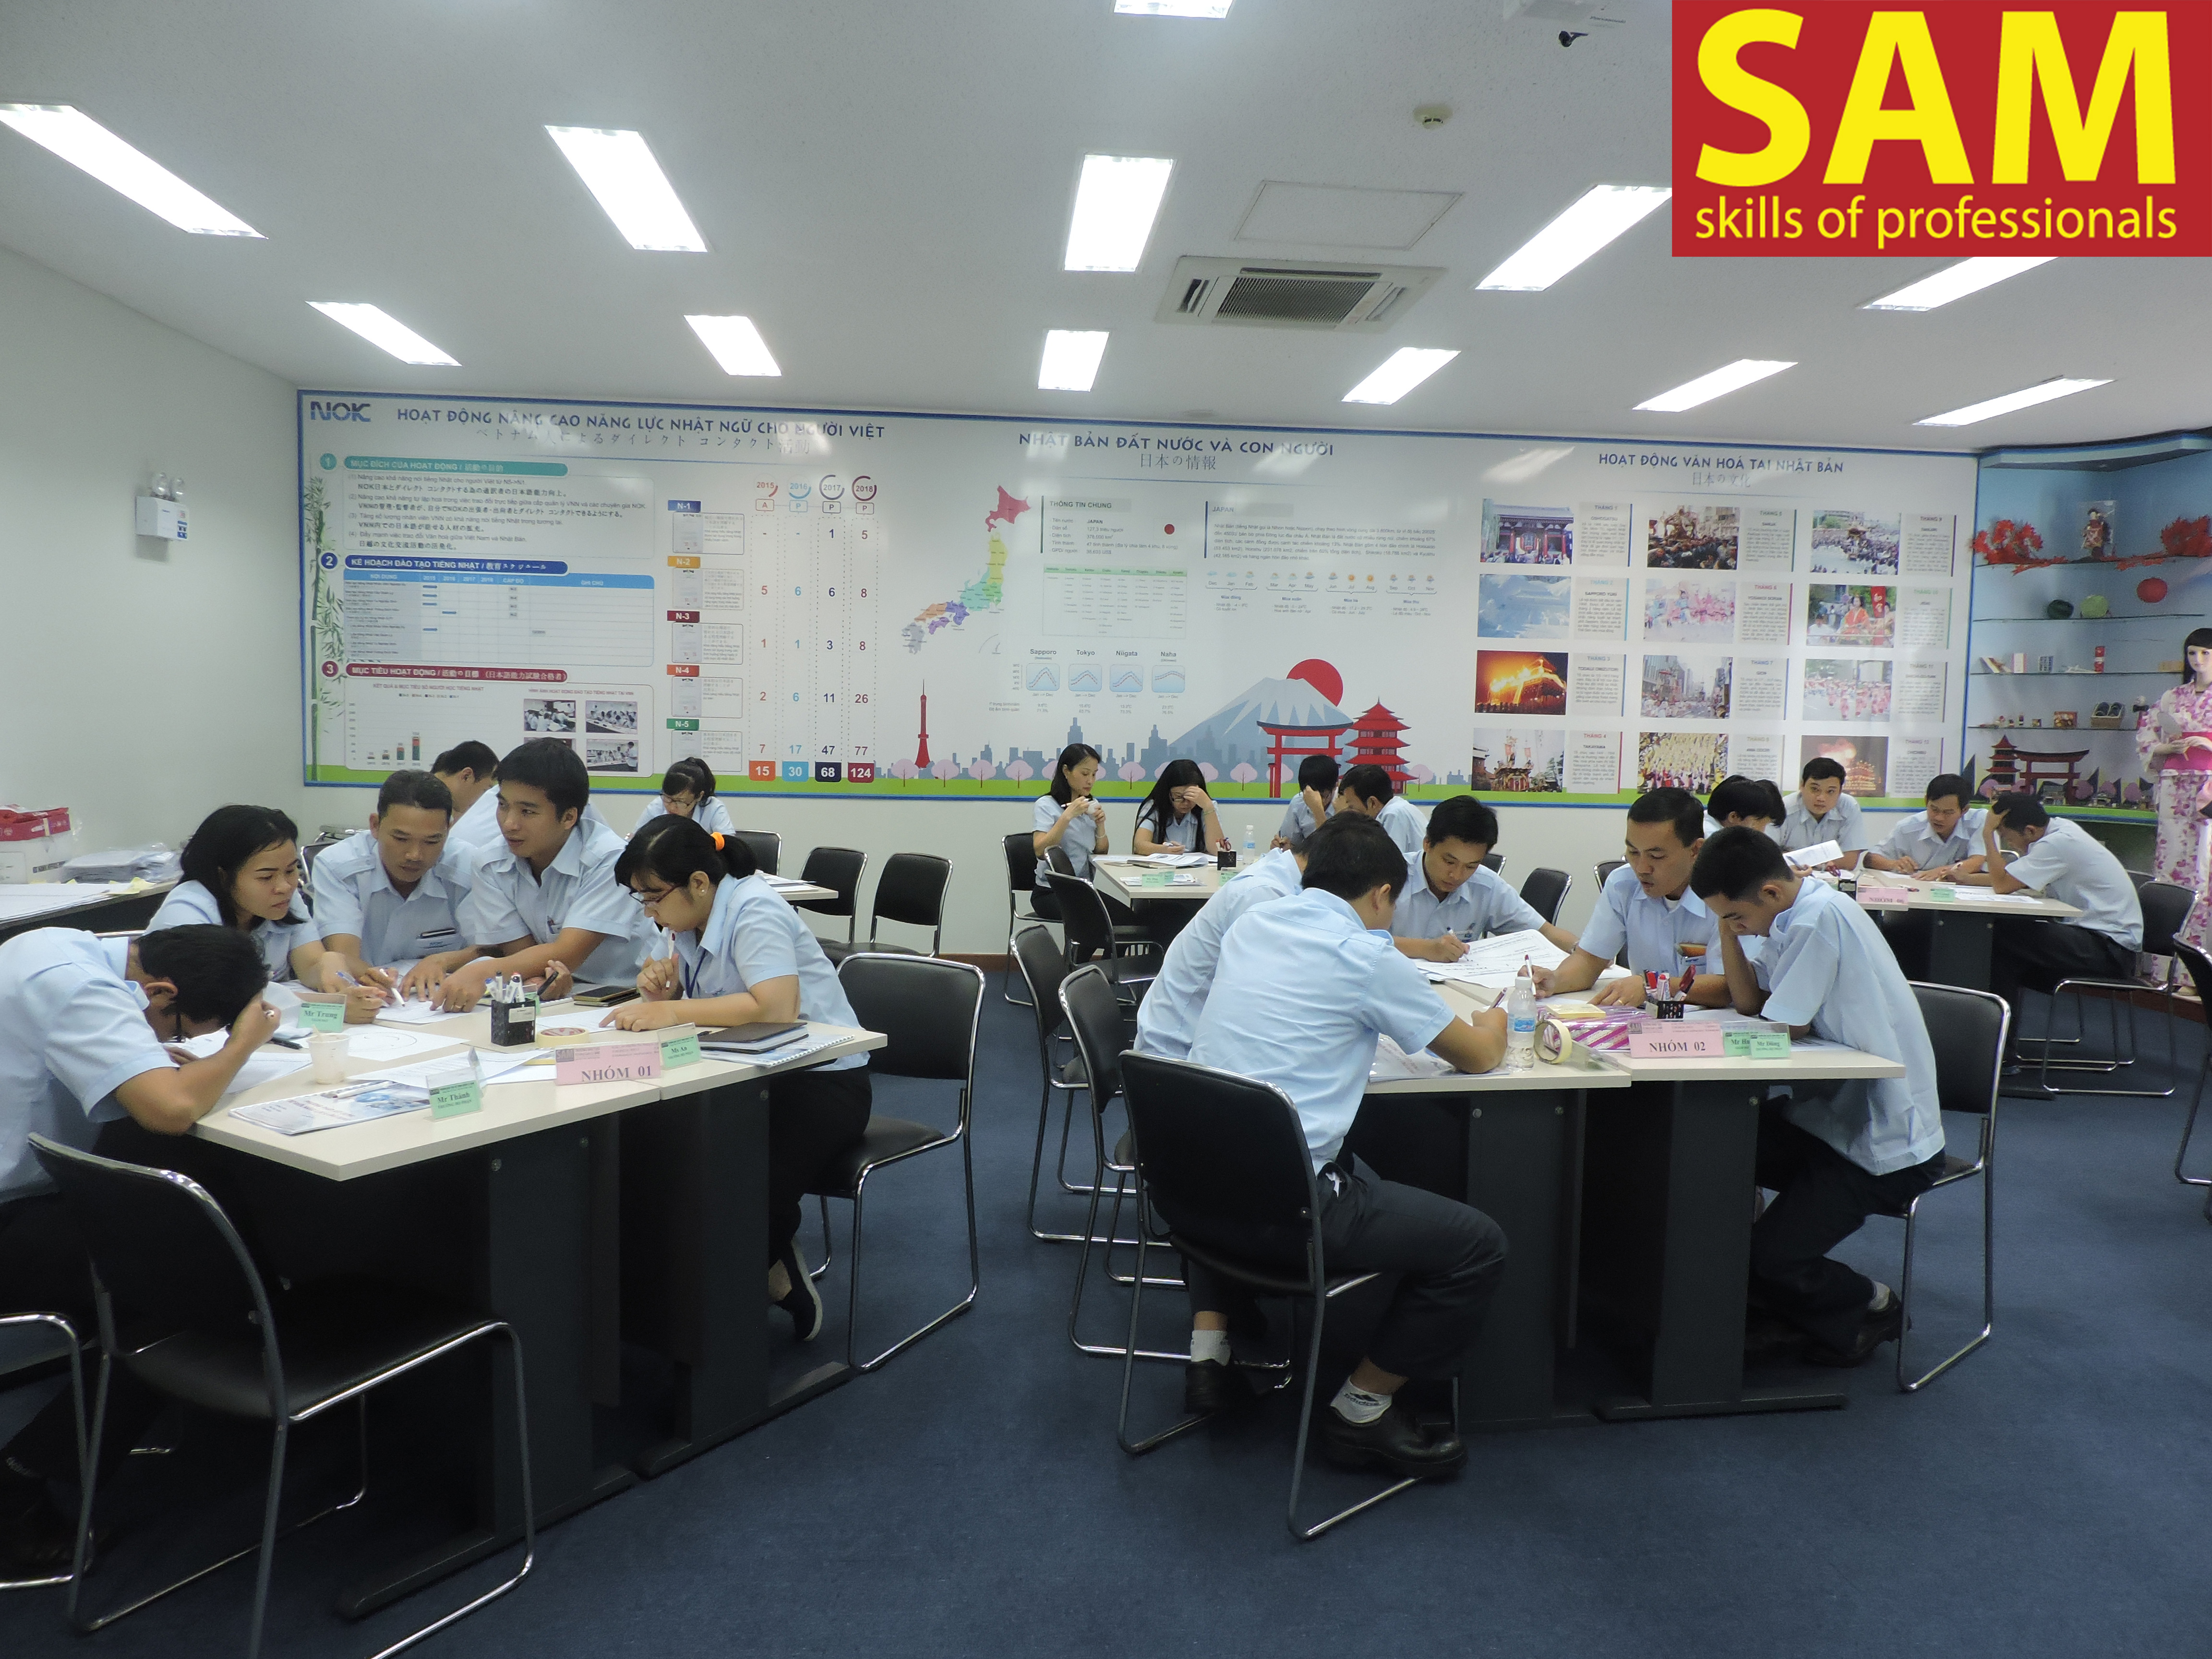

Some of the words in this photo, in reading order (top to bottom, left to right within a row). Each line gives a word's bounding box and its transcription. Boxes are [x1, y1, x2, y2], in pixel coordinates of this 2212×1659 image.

[311, 401, 371, 422] NOK
[398, 409, 441, 424] HOẠT
[447, 408, 492, 425] ĐỘNG
[550, 414, 580, 427] CAO
[587, 413, 630, 429] NĂNG
[638, 416, 664, 433] LỰC
[671, 417, 713, 434] NHẬT
[721, 419, 752, 433] NGỮ
[758, 421, 789, 435] CHO
[850, 423, 884, 440] VIỆT
[1020, 432, 1069, 448] NHẬT
[1075, 431, 1108, 447] BẢN
[1117, 433, 1150, 449] ĐẤT
[1157, 436, 1203, 452] NƯỚC
[1210, 437, 1232, 452] VÀ
[1240, 442, 1274, 454] CON
[1281, 441, 1333, 456] NGƯỜI
[1141, 453, 1216, 470] 日本の情報
[1599, 454, 1635, 468] HOẠT
[1640, 452, 1678, 469] ĐỘNG
[1683, 455, 1710, 468] VĂN
[1716, 456, 1744, 469] HOÁ
[1777, 457, 1812, 474] NHẬT
[1817, 457, 1844, 473] BẢN
[1693, 472, 1751, 488] 日本の文化
[830, 529, 834, 539] 1
[861, 530, 868, 540] 5
[326, 556, 333, 565] 2
[761, 585, 768, 595] 5
[795, 586, 802, 596] 6
[829, 587, 835, 597] 6
[861, 589, 867, 598] 8
[761, 639, 767, 648] 1
[795, 639, 800, 649] 1
[827, 640, 833, 650] 3
[859, 641, 866, 650] 8
[327, 665, 333, 673] 3
[760, 692, 767, 701] 2
[793, 692, 799, 702] 6
[823, 693, 835, 703] 11
[855, 694, 868, 703] 26
[759, 744, 765, 753] 7
[789, 745, 802, 754] 17
[821, 745, 835, 755] 47
[854, 746, 868, 756] 77
[756, 766, 769, 776] 15
[789, 767, 802, 776] 30
[821, 767, 835, 777] 68
[851, 768, 871, 778] 124
[1649, 1039, 1688, 1052] NHÓM
[1694, 1041, 1706, 1051] 02
[581, 1065, 629, 1082] NHÓM
[638, 1065, 651, 1077] 01
